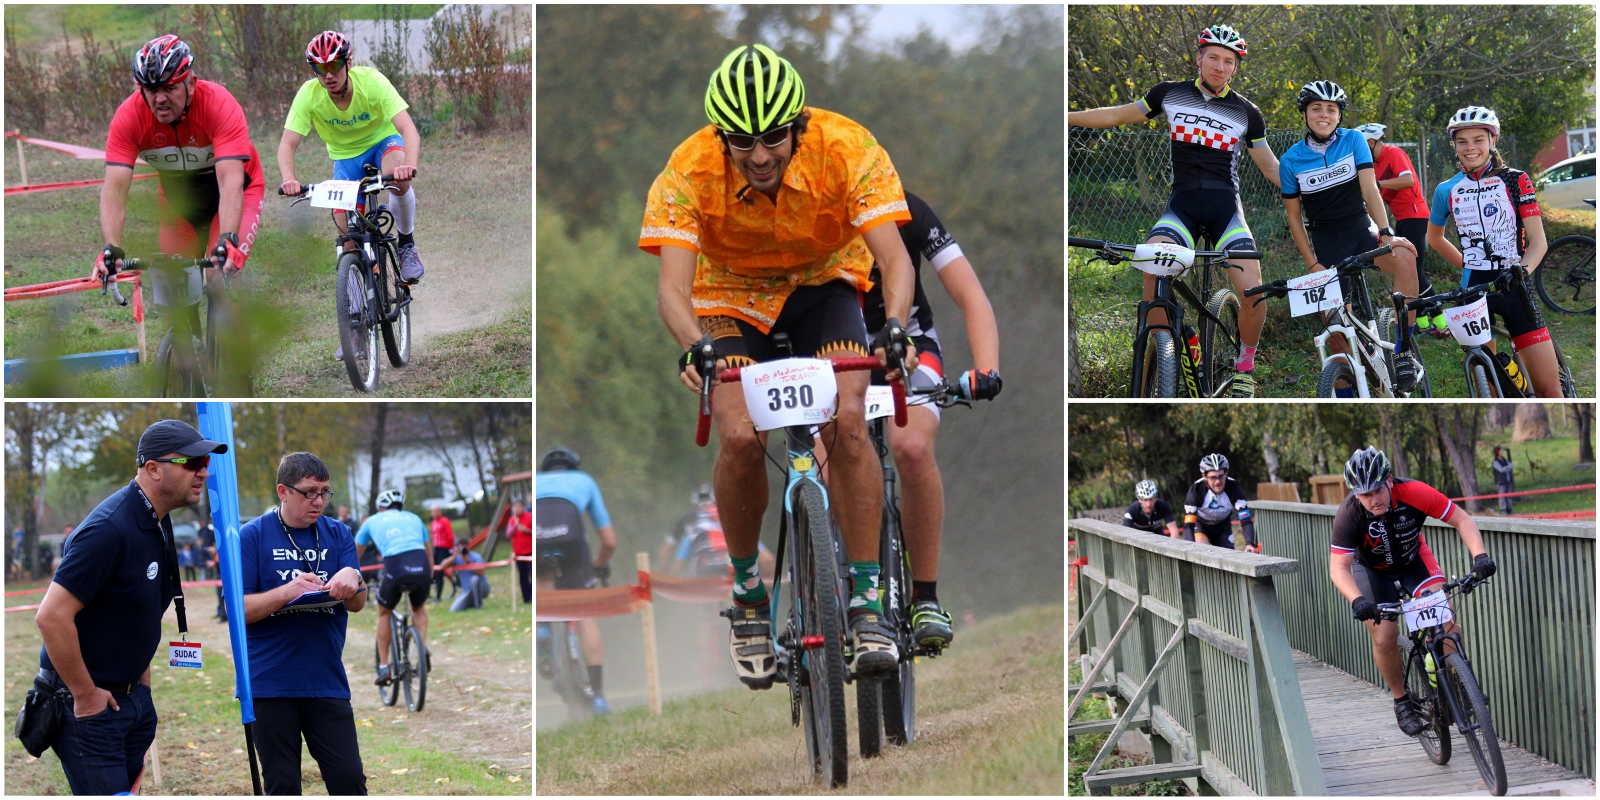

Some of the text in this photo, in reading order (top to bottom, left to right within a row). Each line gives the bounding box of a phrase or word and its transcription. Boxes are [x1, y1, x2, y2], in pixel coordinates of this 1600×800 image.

[325, 114, 357, 126] unicef
[1173, 112, 1233, 131] FORCE
[1317, 166, 1347, 182] VITESSE
[327, 190, 344, 201] 111
[1465, 185, 1500, 194] GIANT
[1154, 251, 1176, 267] 117
[1302, 287, 1327, 305] 162
[1462, 316, 1489, 337] 164
[767, 384, 814, 412] 330
[276, 568, 328, 581] YOR
[889, 576, 899, 610] FOX
[1419, 607, 1438, 621] 112
[174, 649, 197, 659] SUDAC
